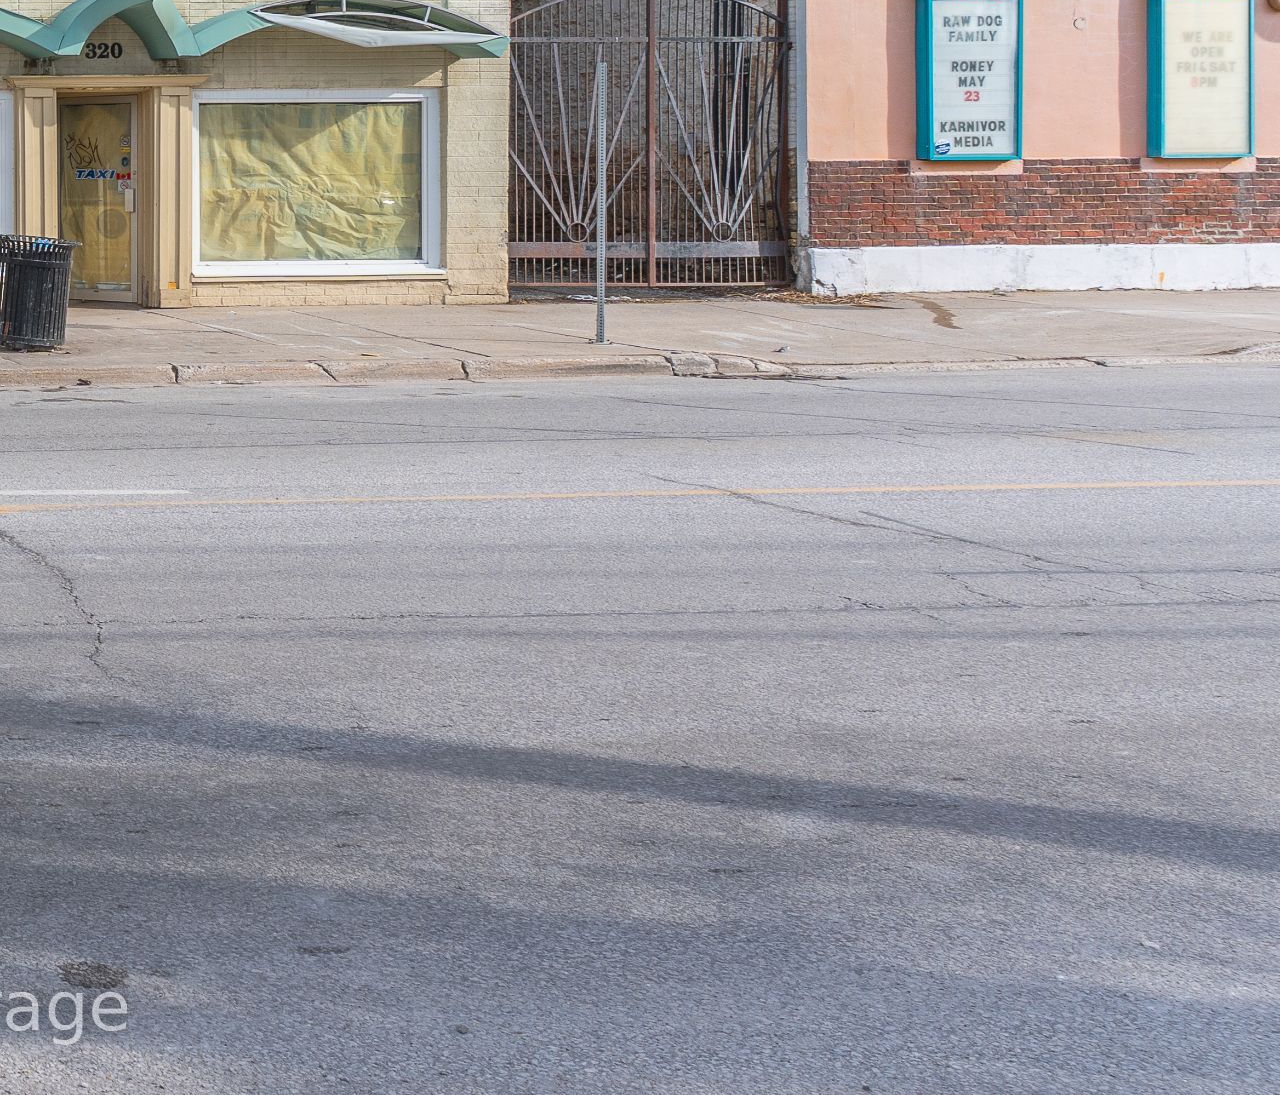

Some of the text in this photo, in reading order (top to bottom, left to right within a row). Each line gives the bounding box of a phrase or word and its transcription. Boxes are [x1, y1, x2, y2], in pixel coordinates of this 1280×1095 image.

[943, 15, 1003, 27] RAW DOG
[948, 30, 997, 42] FAMILY
[84, 42, 123, 60] 320
[1191, 46, 1224, 57] OPEN
[951, 60, 994, 72] RONEY
[958, 76, 985, 87] MAY
[964, 91, 980, 101] 23
[940, 120, 1006, 132] KARNIVOR
[954, 136, 993, 147] MEDIA
[76, 169, 116, 179] TAXI
